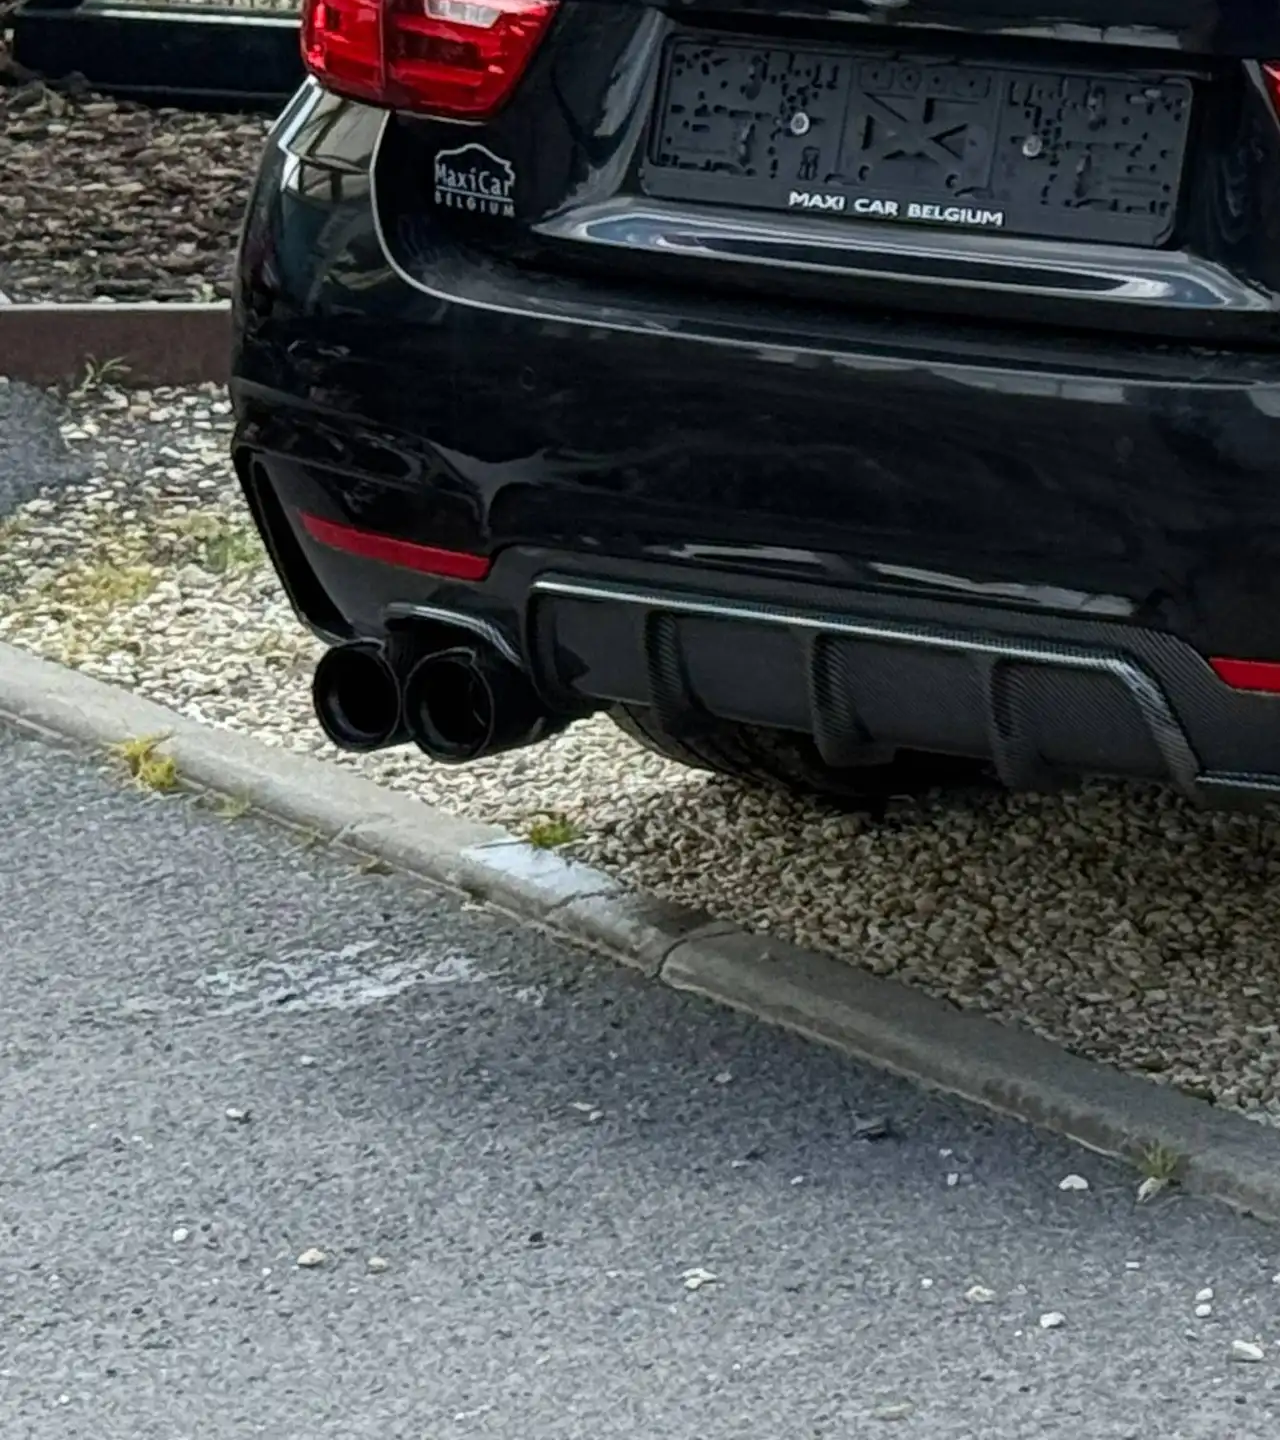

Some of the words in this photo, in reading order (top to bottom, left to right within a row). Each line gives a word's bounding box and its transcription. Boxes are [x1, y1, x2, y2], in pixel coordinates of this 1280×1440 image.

[434, 189, 516, 218] BELGIUM
[788, 190, 845, 210] MAXI
[854, 197, 899, 217] CAR
[907, 202, 1004, 227] BELGIUM
